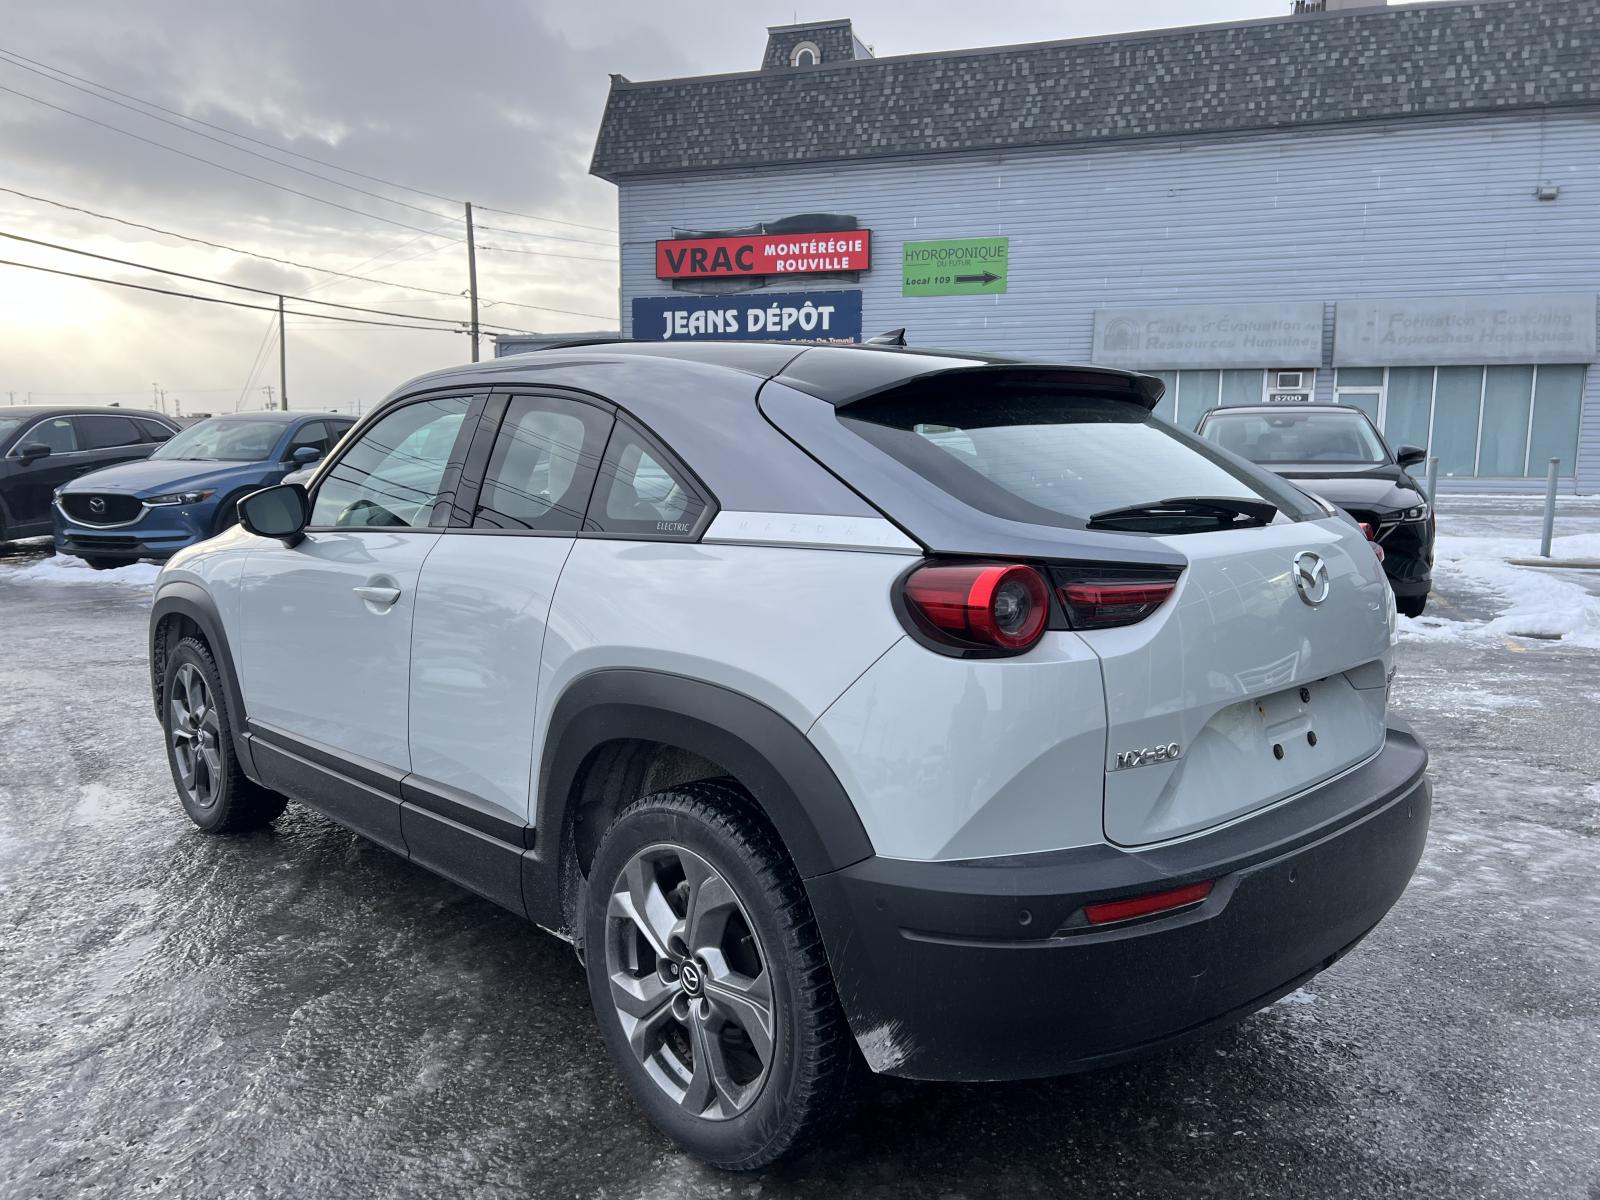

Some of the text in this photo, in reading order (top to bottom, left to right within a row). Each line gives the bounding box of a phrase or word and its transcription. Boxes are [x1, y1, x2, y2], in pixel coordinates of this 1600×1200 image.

[764, 238, 863, 257] MONTÉRÉGIE
[905, 246, 1005, 262] HYDROPONIQUE
[665, 245, 755, 273] VRAC
[776, 256, 849, 272] ROUVILLE
[937, 259, 972, 268] DU FUTUR
[906, 276, 951, 286] Local 109
[662, 301, 835, 340] JEANS DÉPÔT
[656, 521, 690, 532] ELECTRIC
[1115, 742, 1180, 769] MX-30
